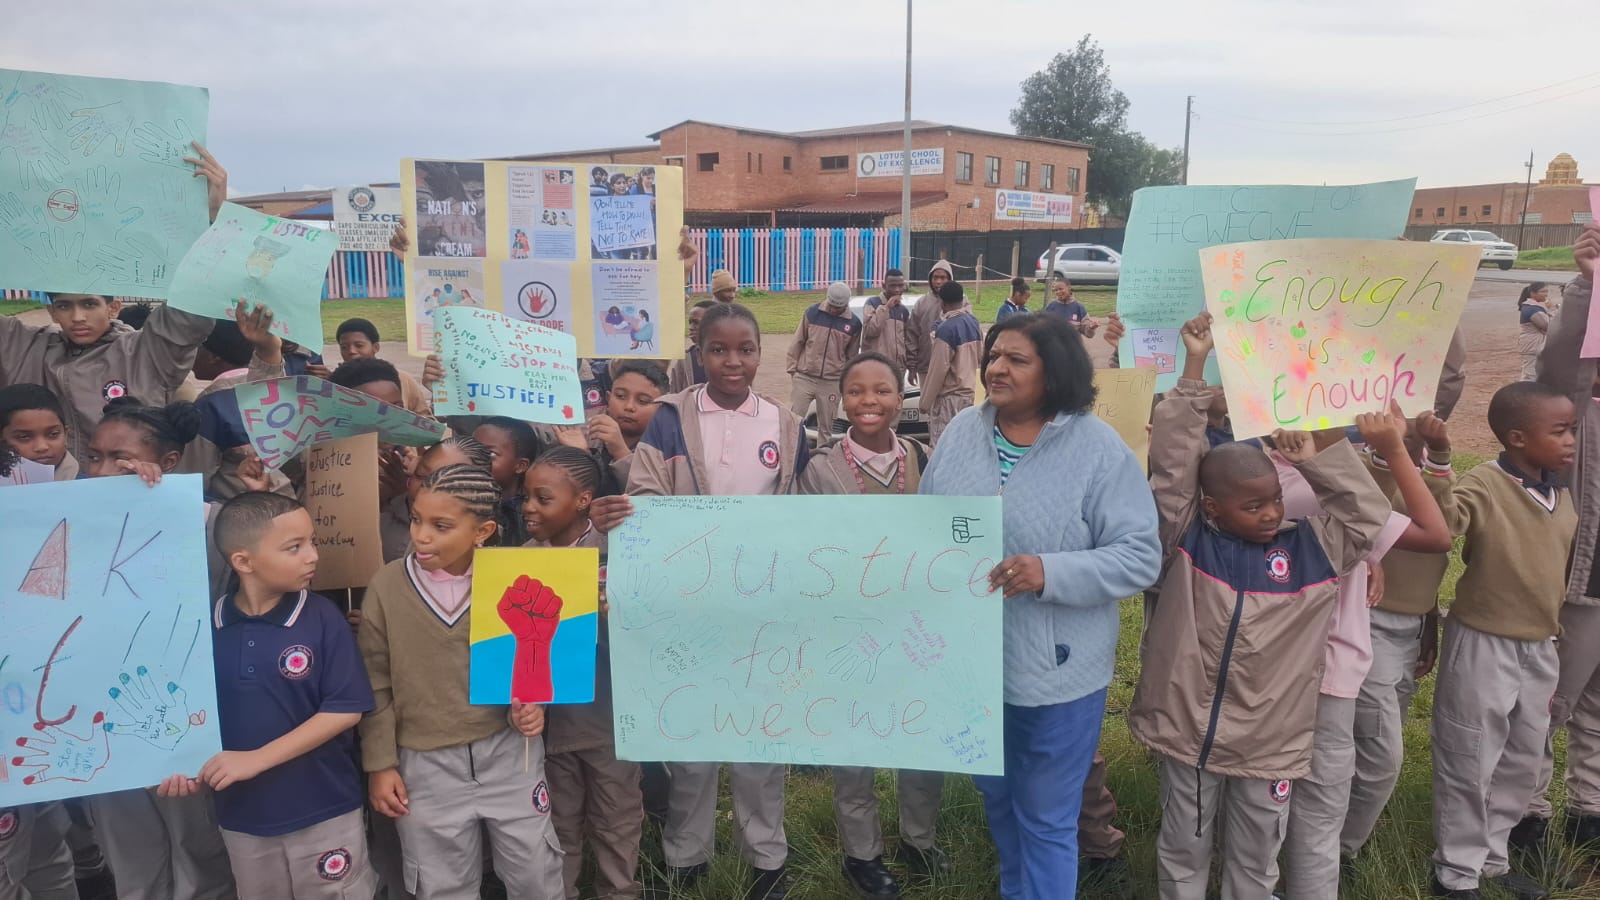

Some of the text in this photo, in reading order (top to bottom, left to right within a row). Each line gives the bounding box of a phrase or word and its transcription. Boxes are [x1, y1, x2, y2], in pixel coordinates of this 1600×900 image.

[911, 150, 941, 159] CHOOL
[890, 158, 941, 167] EXCLLENCE
[427, 201, 477, 215] NATIN'S
[261, 216, 321, 242] JUSTICE
[597, 220, 613, 231] TELL
[598, 232, 614, 247] NOT
[435, 242, 472, 257] SCREAM
[443, 269, 470, 278] AGAINST
[1245, 259, 1446, 328] Enough
[509, 354, 547, 368] STOP
[1273, 352, 1416, 425] Enough
[907, 409, 918, 420] GP
[309, 448, 352, 471] Justice
[310, 480, 344, 496] Justice
[315, 505, 336, 526] for
[663, 524, 998, 600] Justice
[731, 621, 814, 688] for
